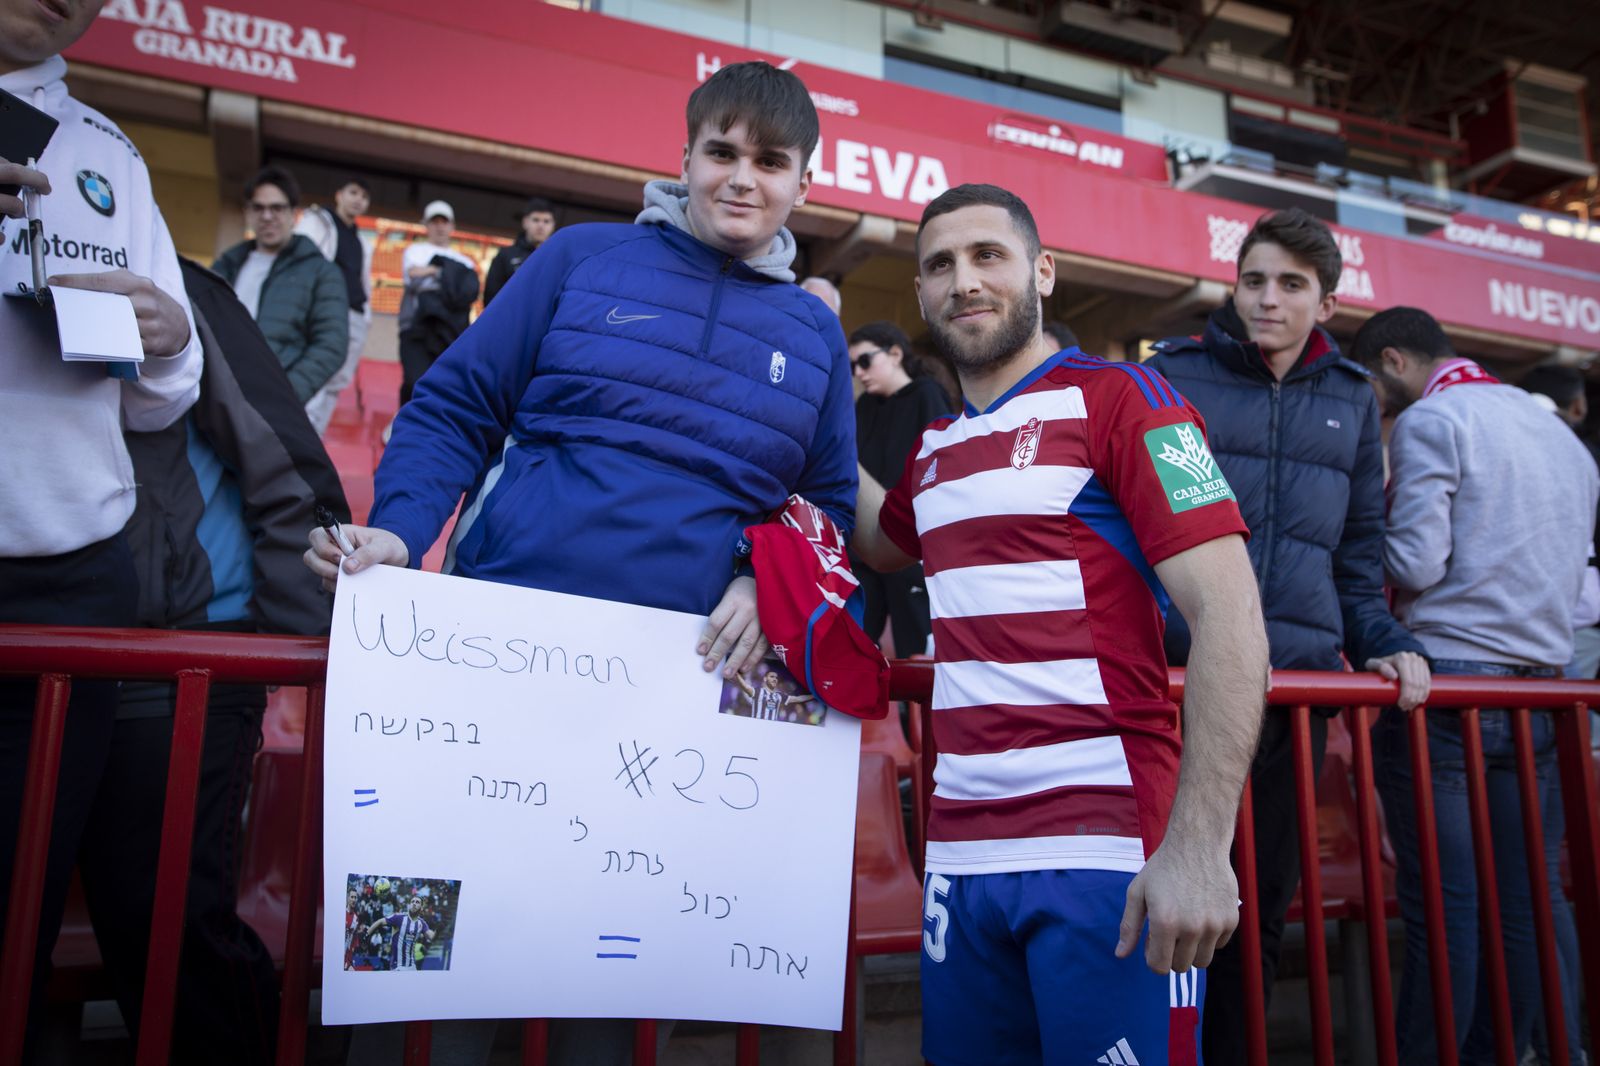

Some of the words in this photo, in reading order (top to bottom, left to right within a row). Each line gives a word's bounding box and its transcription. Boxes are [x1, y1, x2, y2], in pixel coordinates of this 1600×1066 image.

[97, 0, 193, 34] AJA
[202, 6, 356, 69] RURAL
[133, 28, 298, 83] GRANADA
[1488, 278, 1600, 333] NUEVO
[1173, 485, 1203, 501] CAJA
[352, 593, 636, 687] Weissman
[730, 942, 808, 980] אתה
